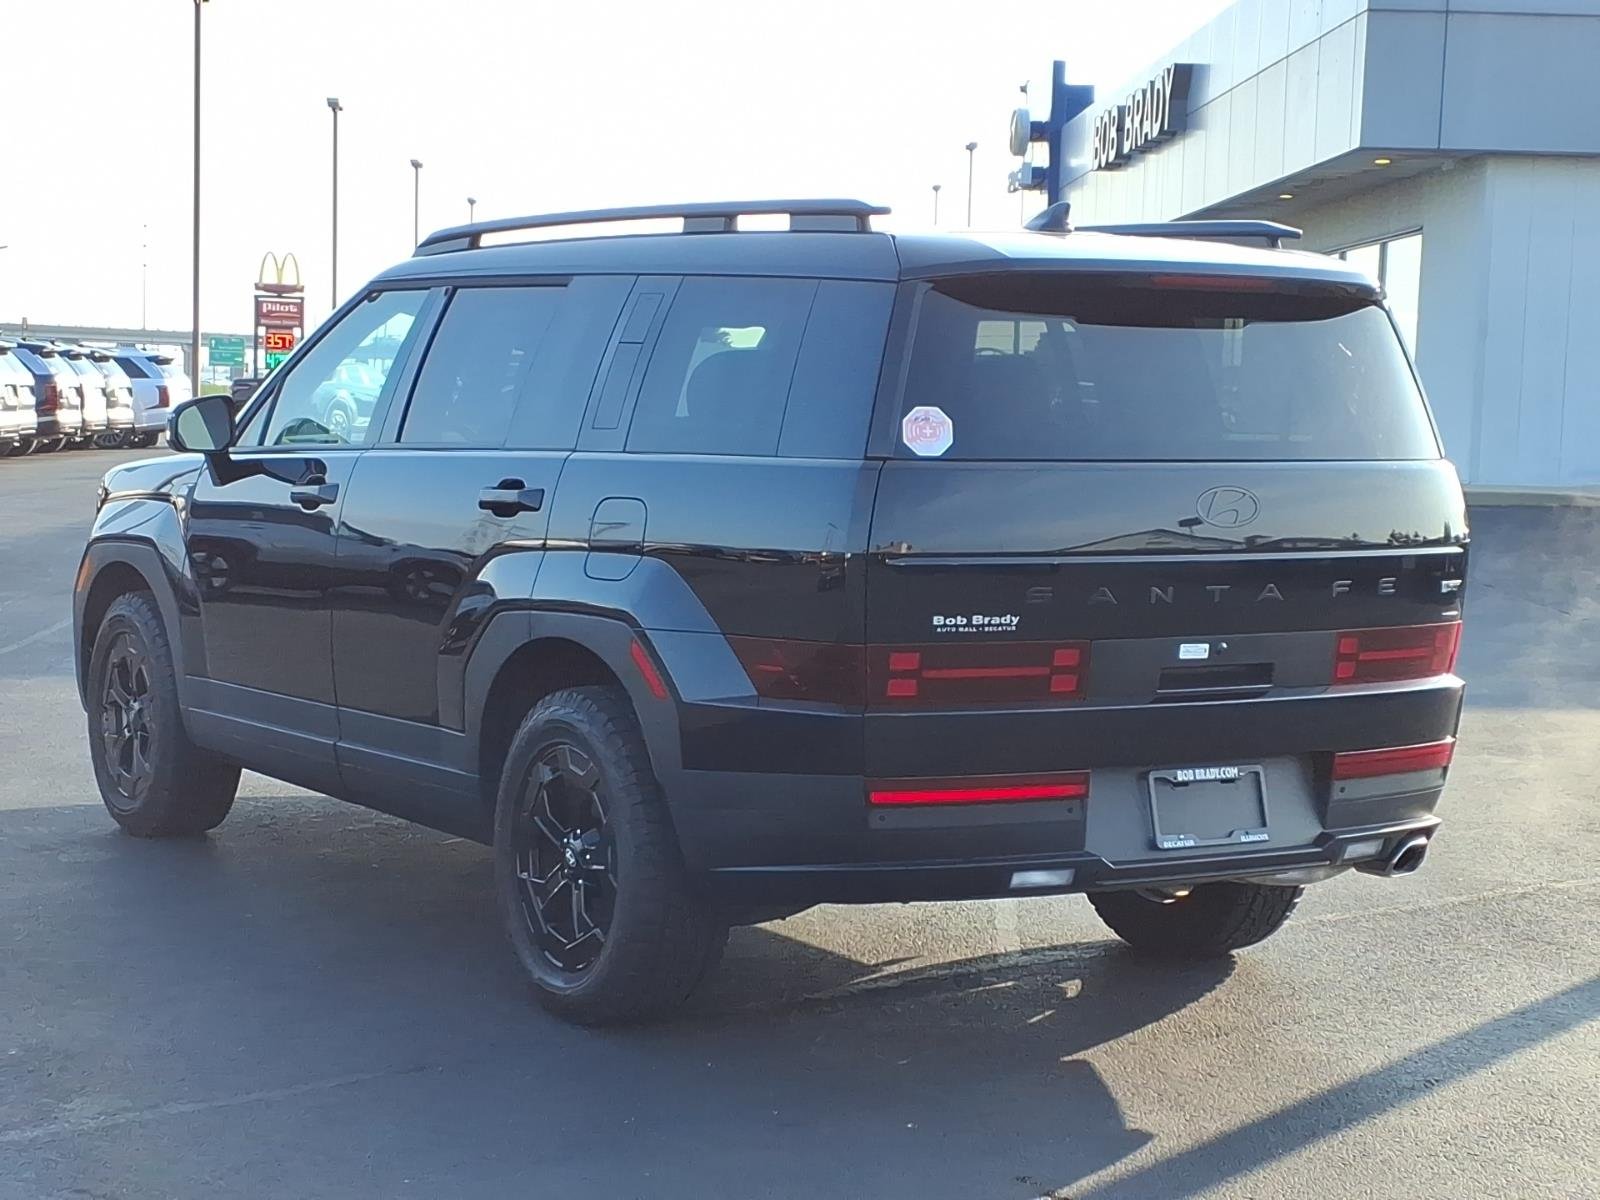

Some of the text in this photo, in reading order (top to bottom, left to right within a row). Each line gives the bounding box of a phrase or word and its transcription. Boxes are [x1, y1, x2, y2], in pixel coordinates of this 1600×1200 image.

[1092, 63, 1176, 171] BOB BRADY
[262, 302, 298, 313] Pilot
[1025, 577, 1397, 604] SANTA FE
[933, 614, 1020, 626] Bob Brady
[1177, 769, 1194, 781] BOB
